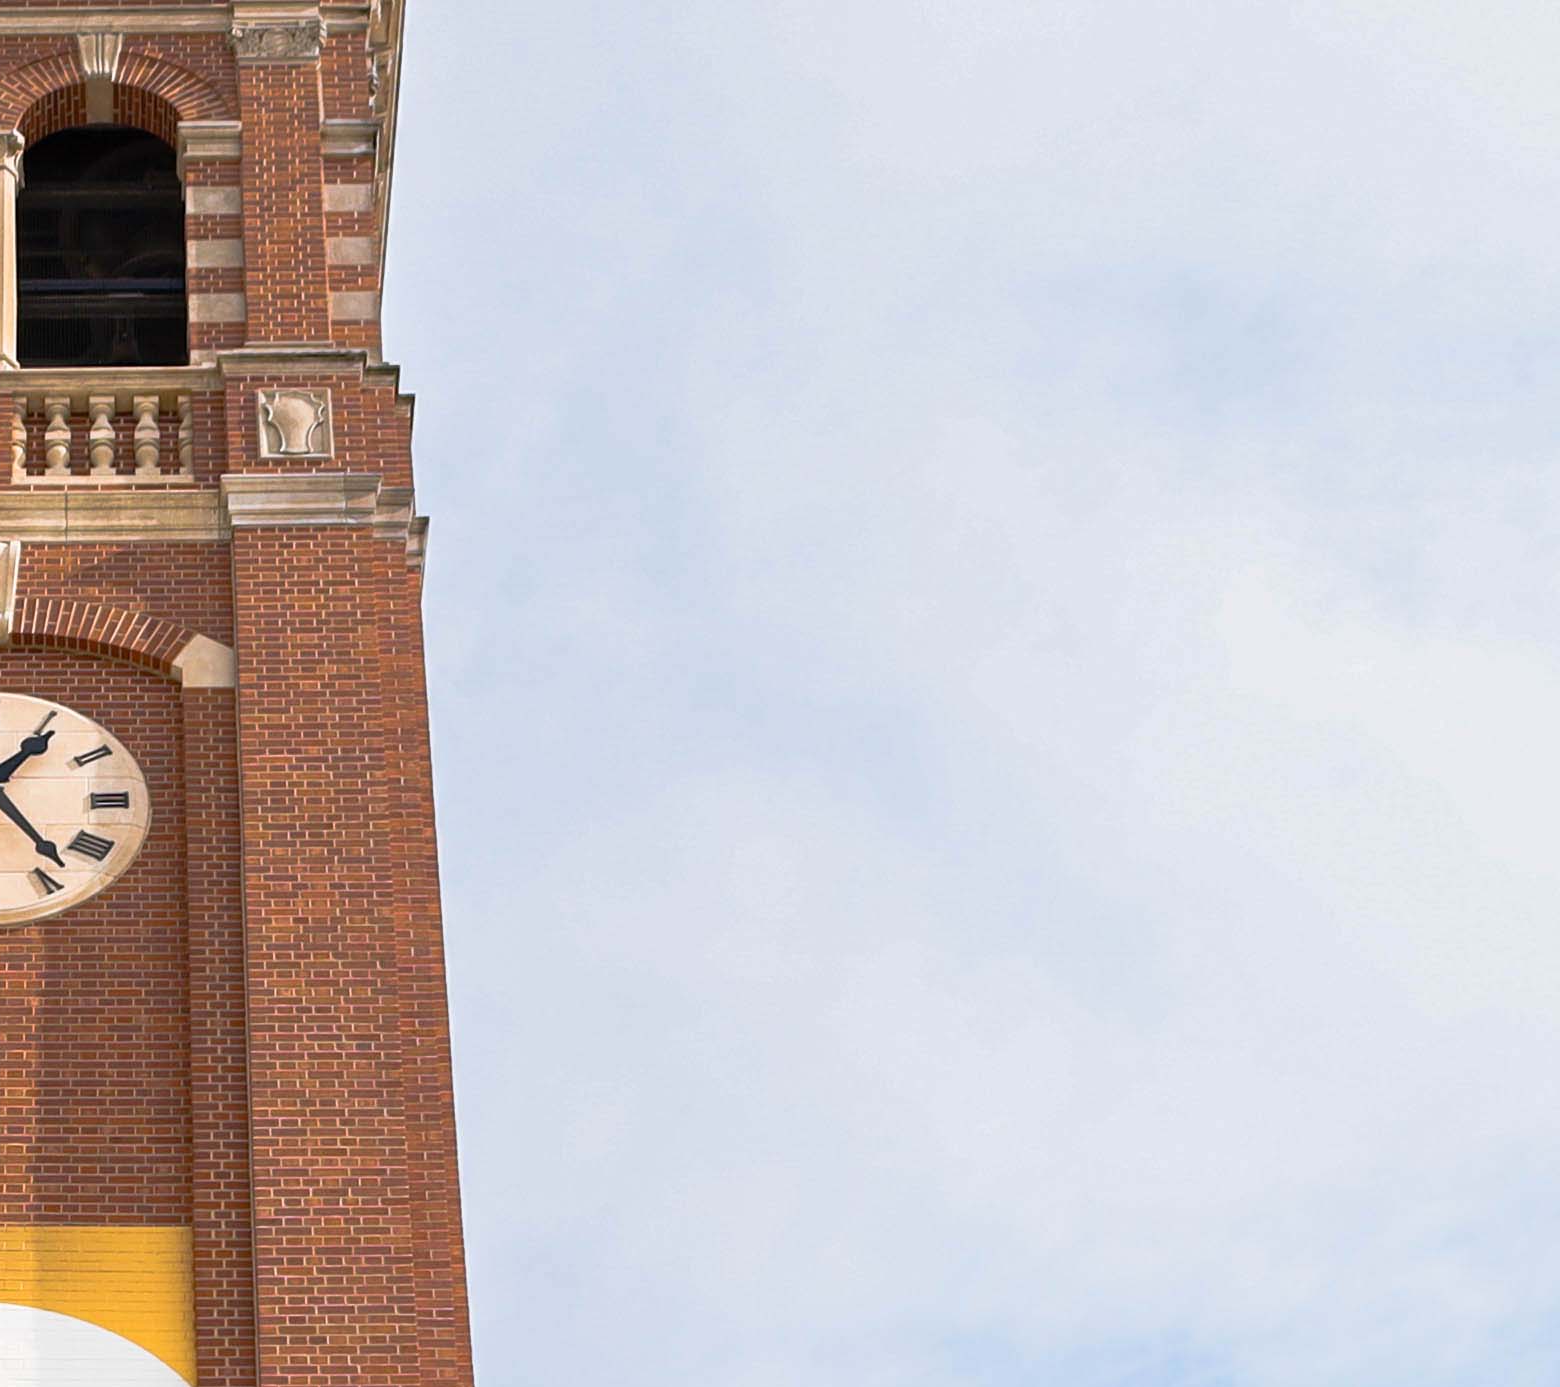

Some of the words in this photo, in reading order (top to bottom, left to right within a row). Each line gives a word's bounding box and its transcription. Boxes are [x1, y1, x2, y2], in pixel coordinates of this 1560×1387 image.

[74, 744, 113, 767] II
[91, 791, 129, 809] III
[67, 829, 115, 861] IIII
[33, 867, 64, 895] V
